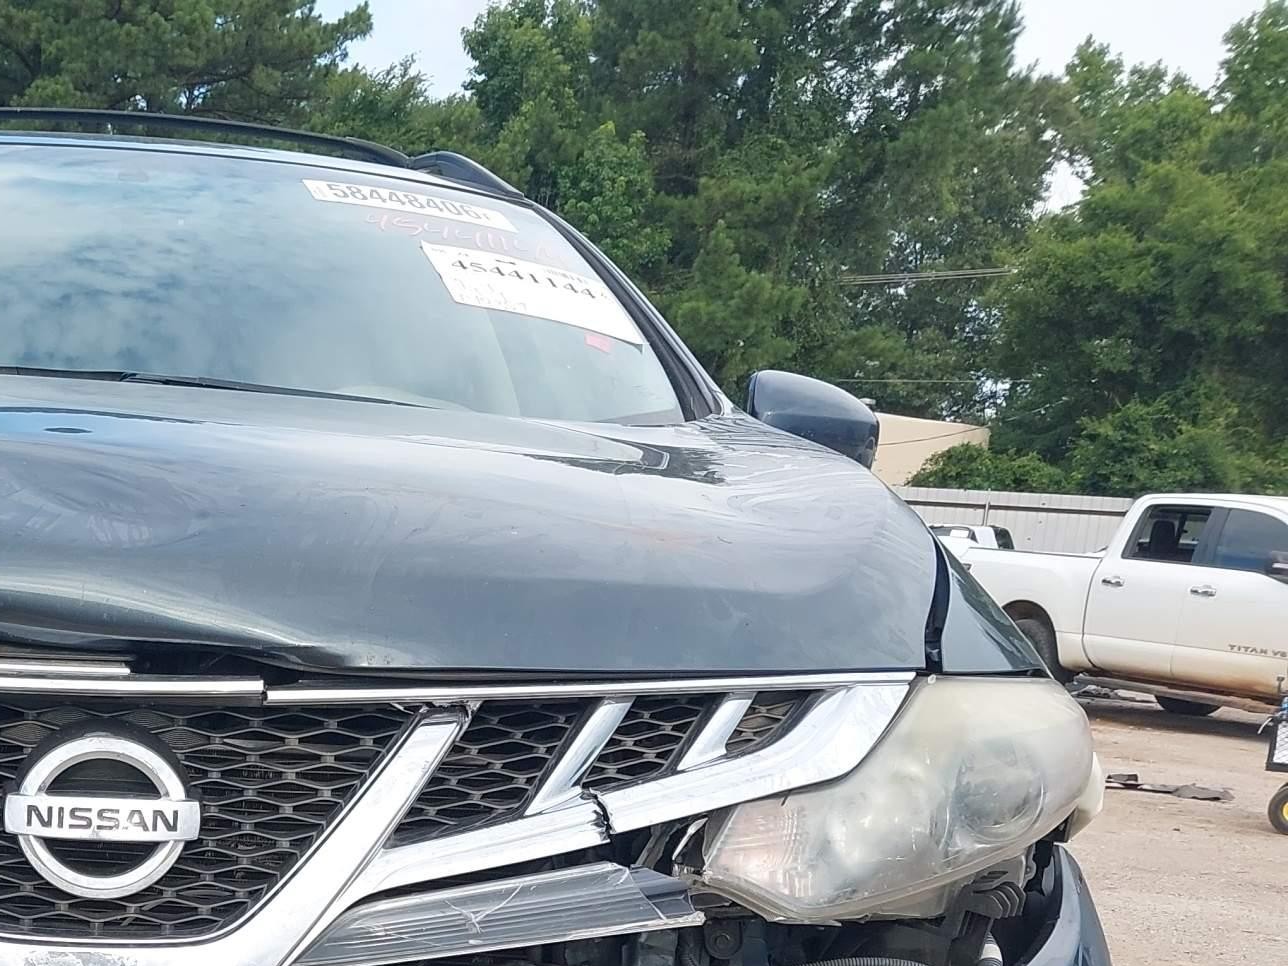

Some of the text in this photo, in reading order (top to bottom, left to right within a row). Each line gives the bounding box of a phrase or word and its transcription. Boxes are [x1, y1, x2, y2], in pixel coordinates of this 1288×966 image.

[327, 183, 480, 221] 58448406
[451, 259, 597, 299] 45441144
[1227, 643, 1268, 655] TITAN
[25, 803, 180, 833] NISSAN
